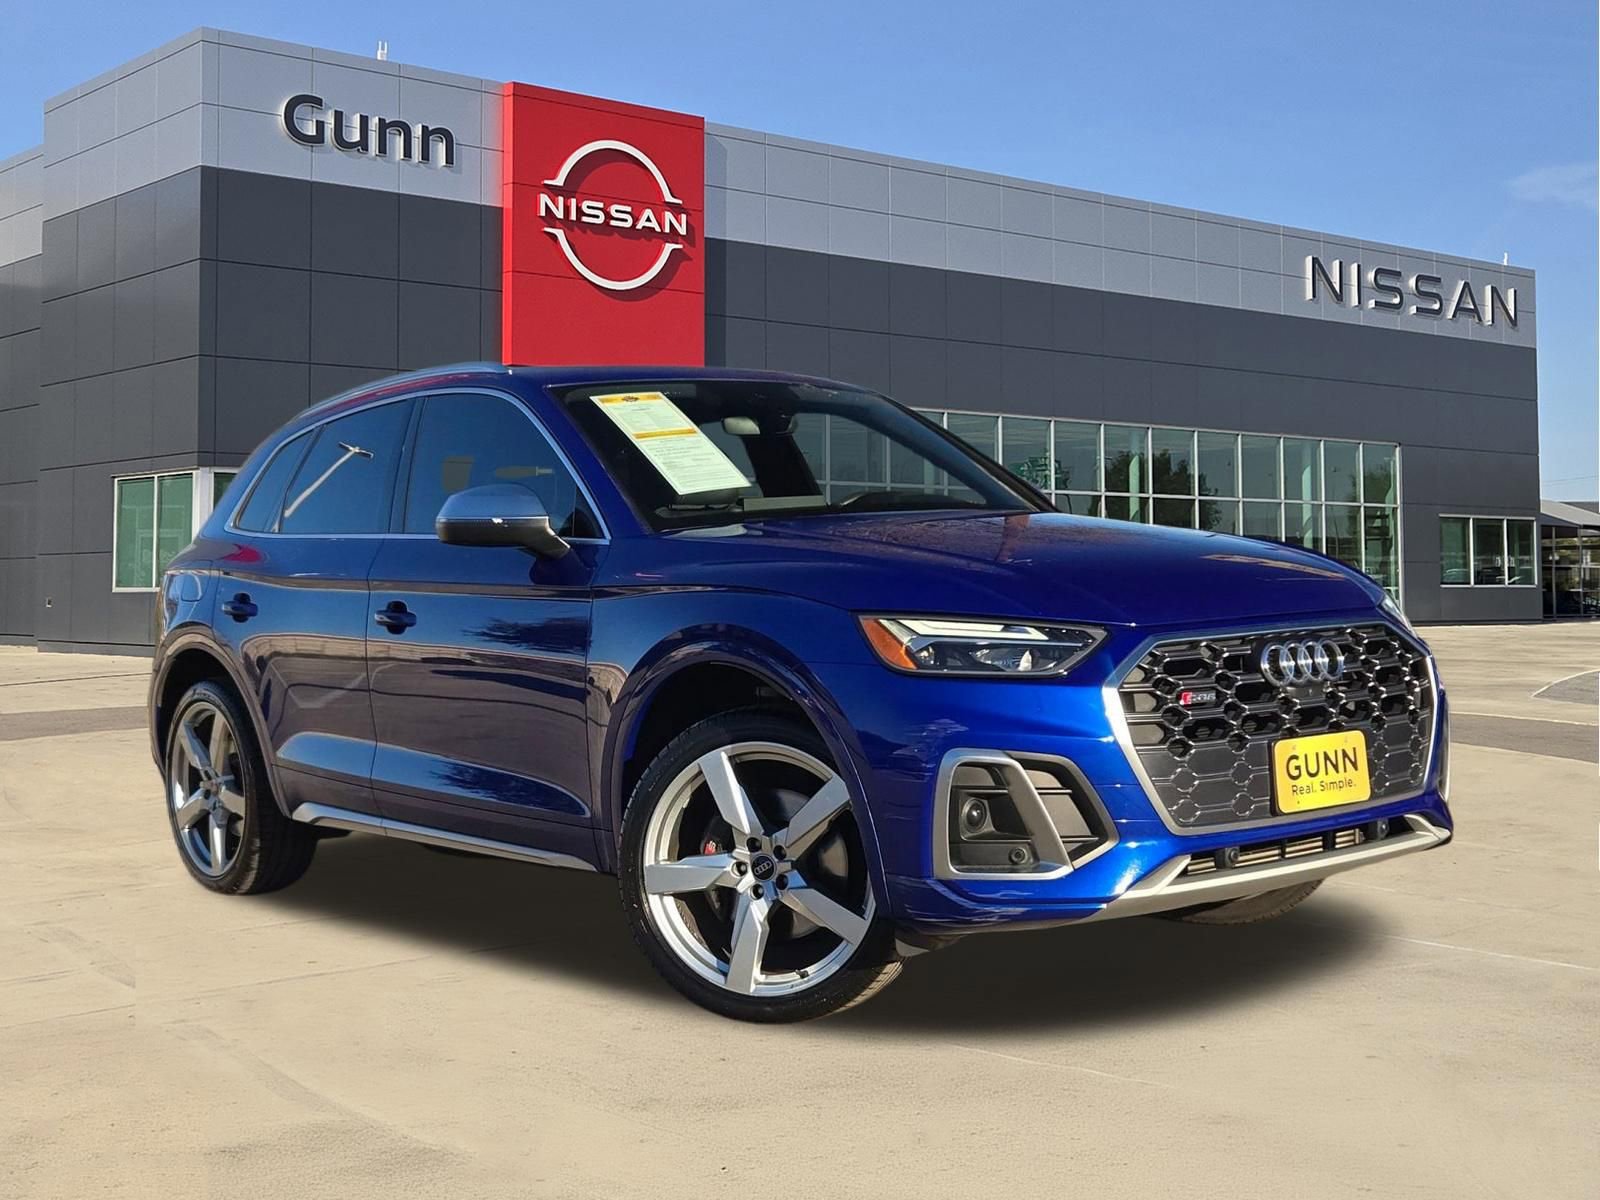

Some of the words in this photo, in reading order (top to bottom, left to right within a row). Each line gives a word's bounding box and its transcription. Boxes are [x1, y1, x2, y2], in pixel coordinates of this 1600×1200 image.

[282, 93, 455, 168] Gunn
[537, 193, 687, 236] NISSAN
[1305, 255, 1518, 328] NISSAN
[1286, 747, 1359, 781] GUNN
[1291, 783, 1318, 796] Real.
[1319, 778, 1357, 794] Simple.
